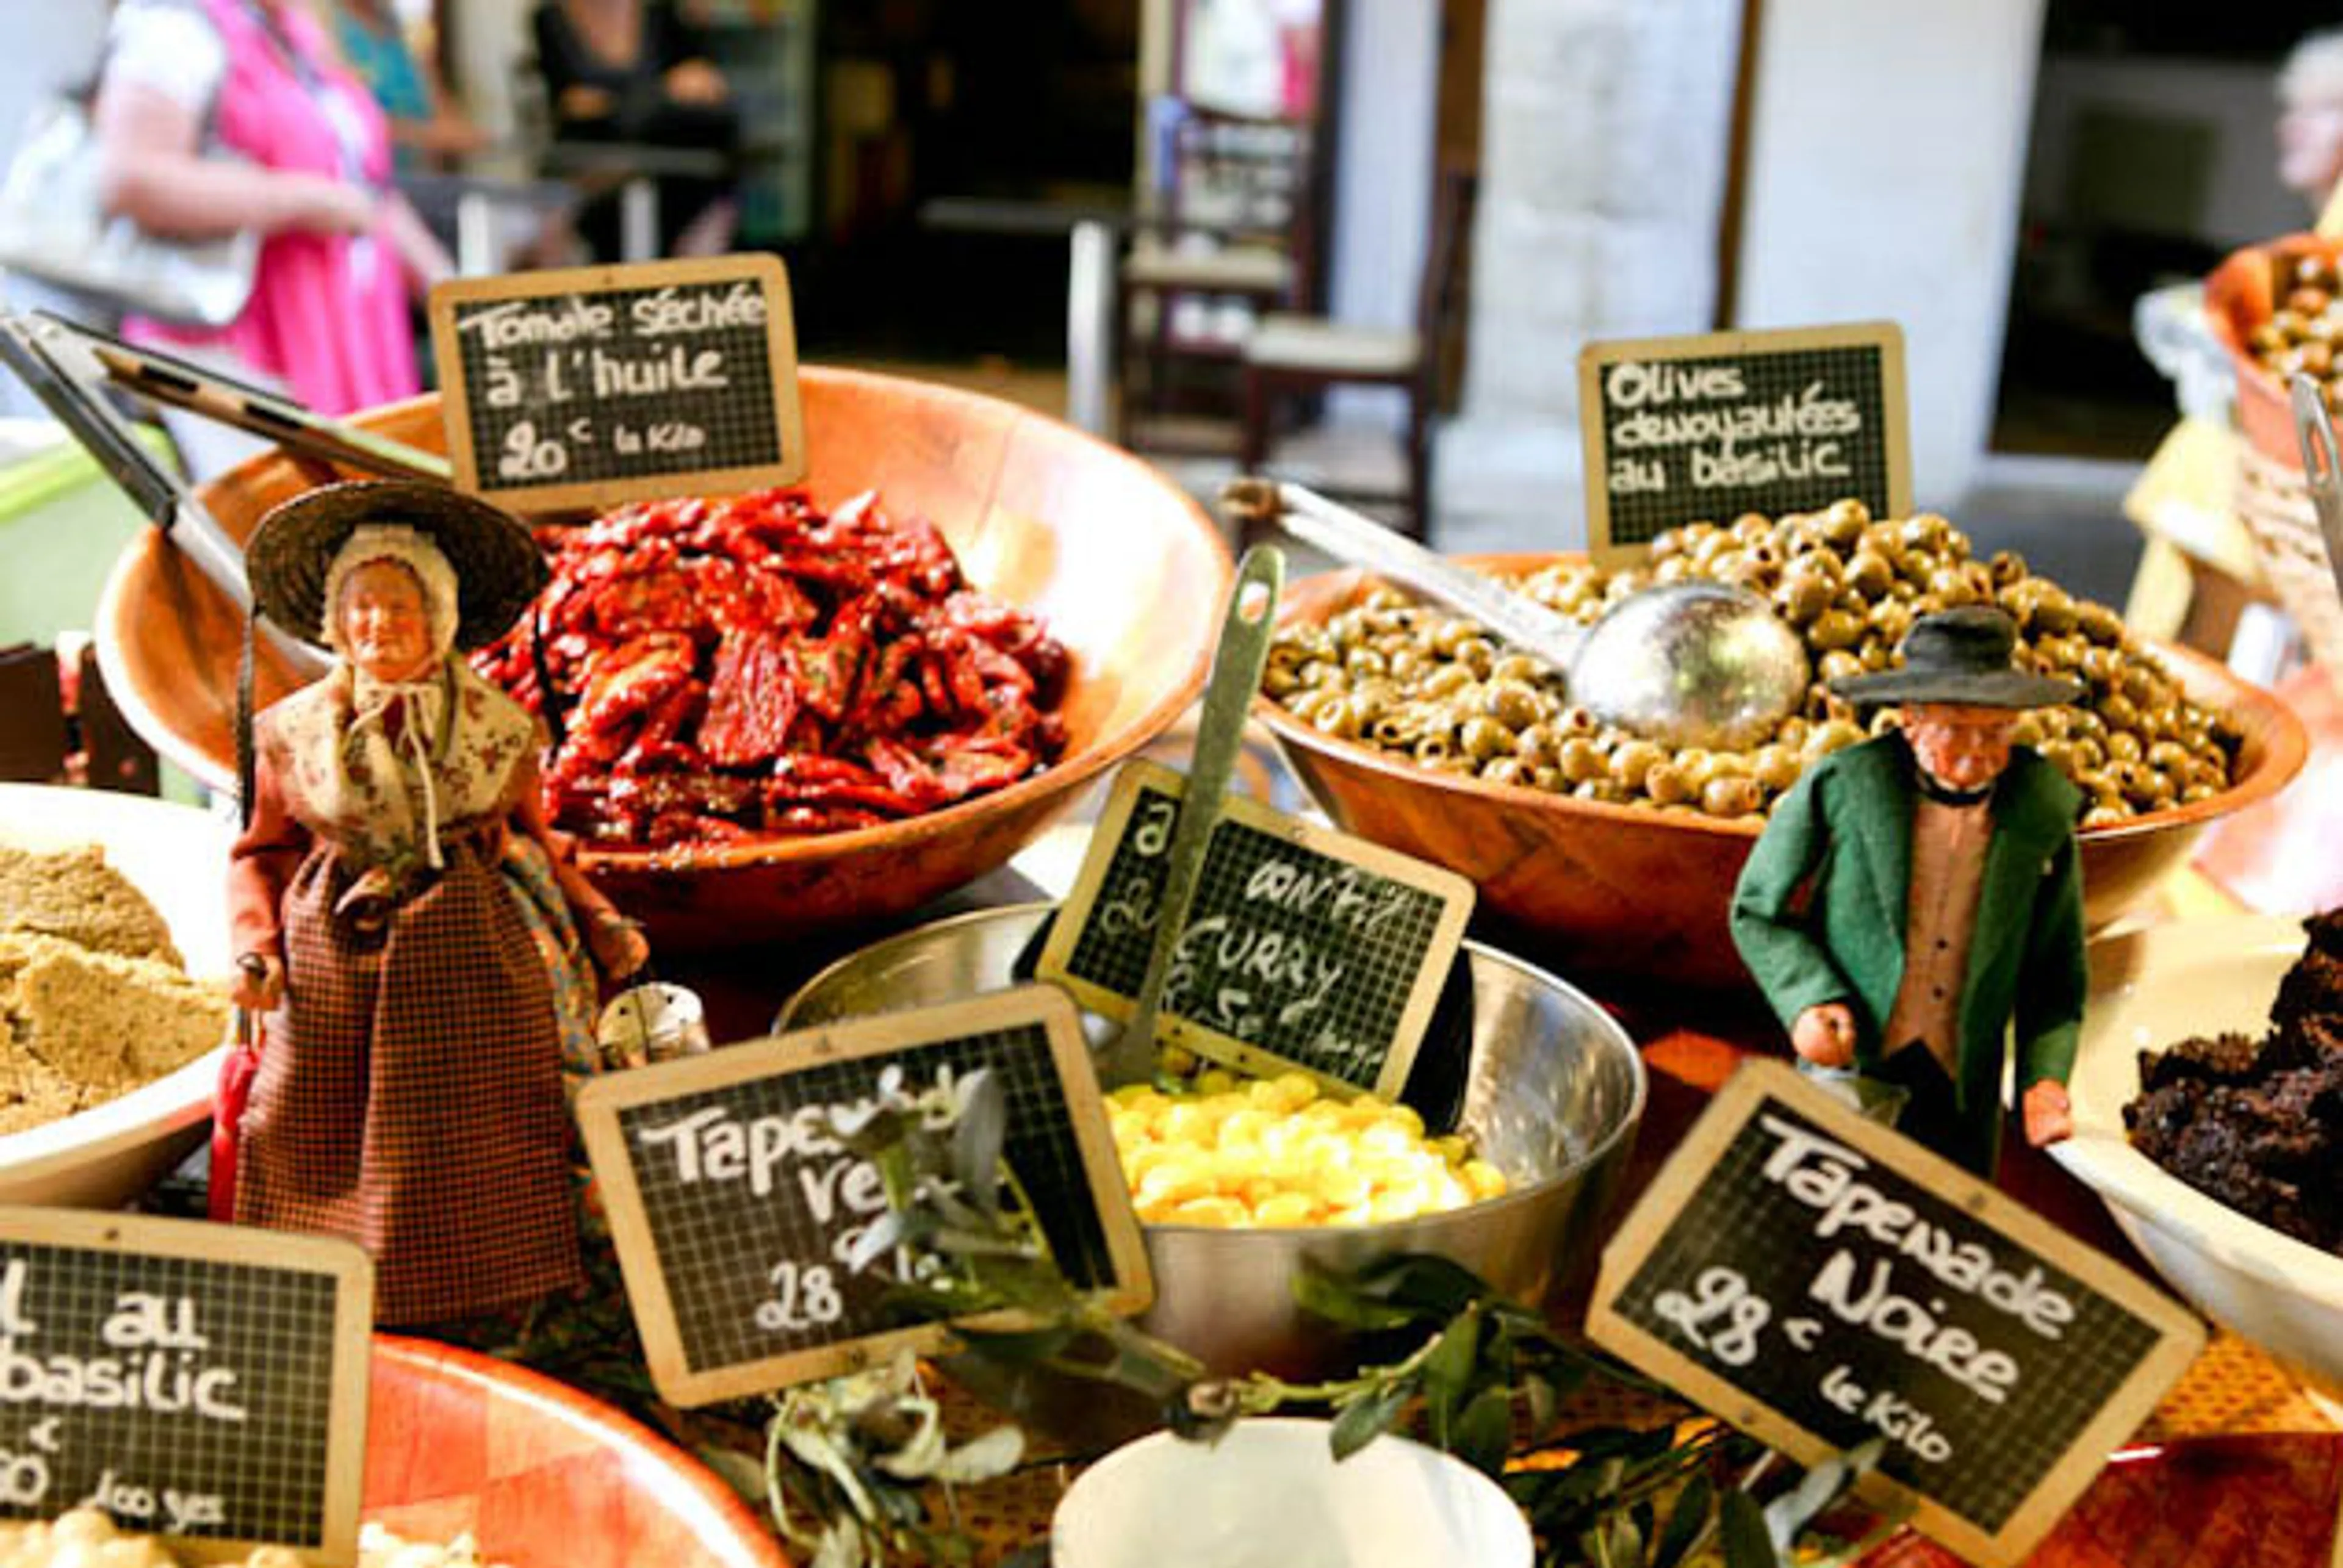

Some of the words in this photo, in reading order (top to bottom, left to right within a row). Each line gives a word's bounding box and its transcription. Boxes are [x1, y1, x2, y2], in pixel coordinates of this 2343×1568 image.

[1608, 363, 1746, 408] Olives
[1609, 456, 1665, 492] au
[103, 1292, 211, 1348] au
